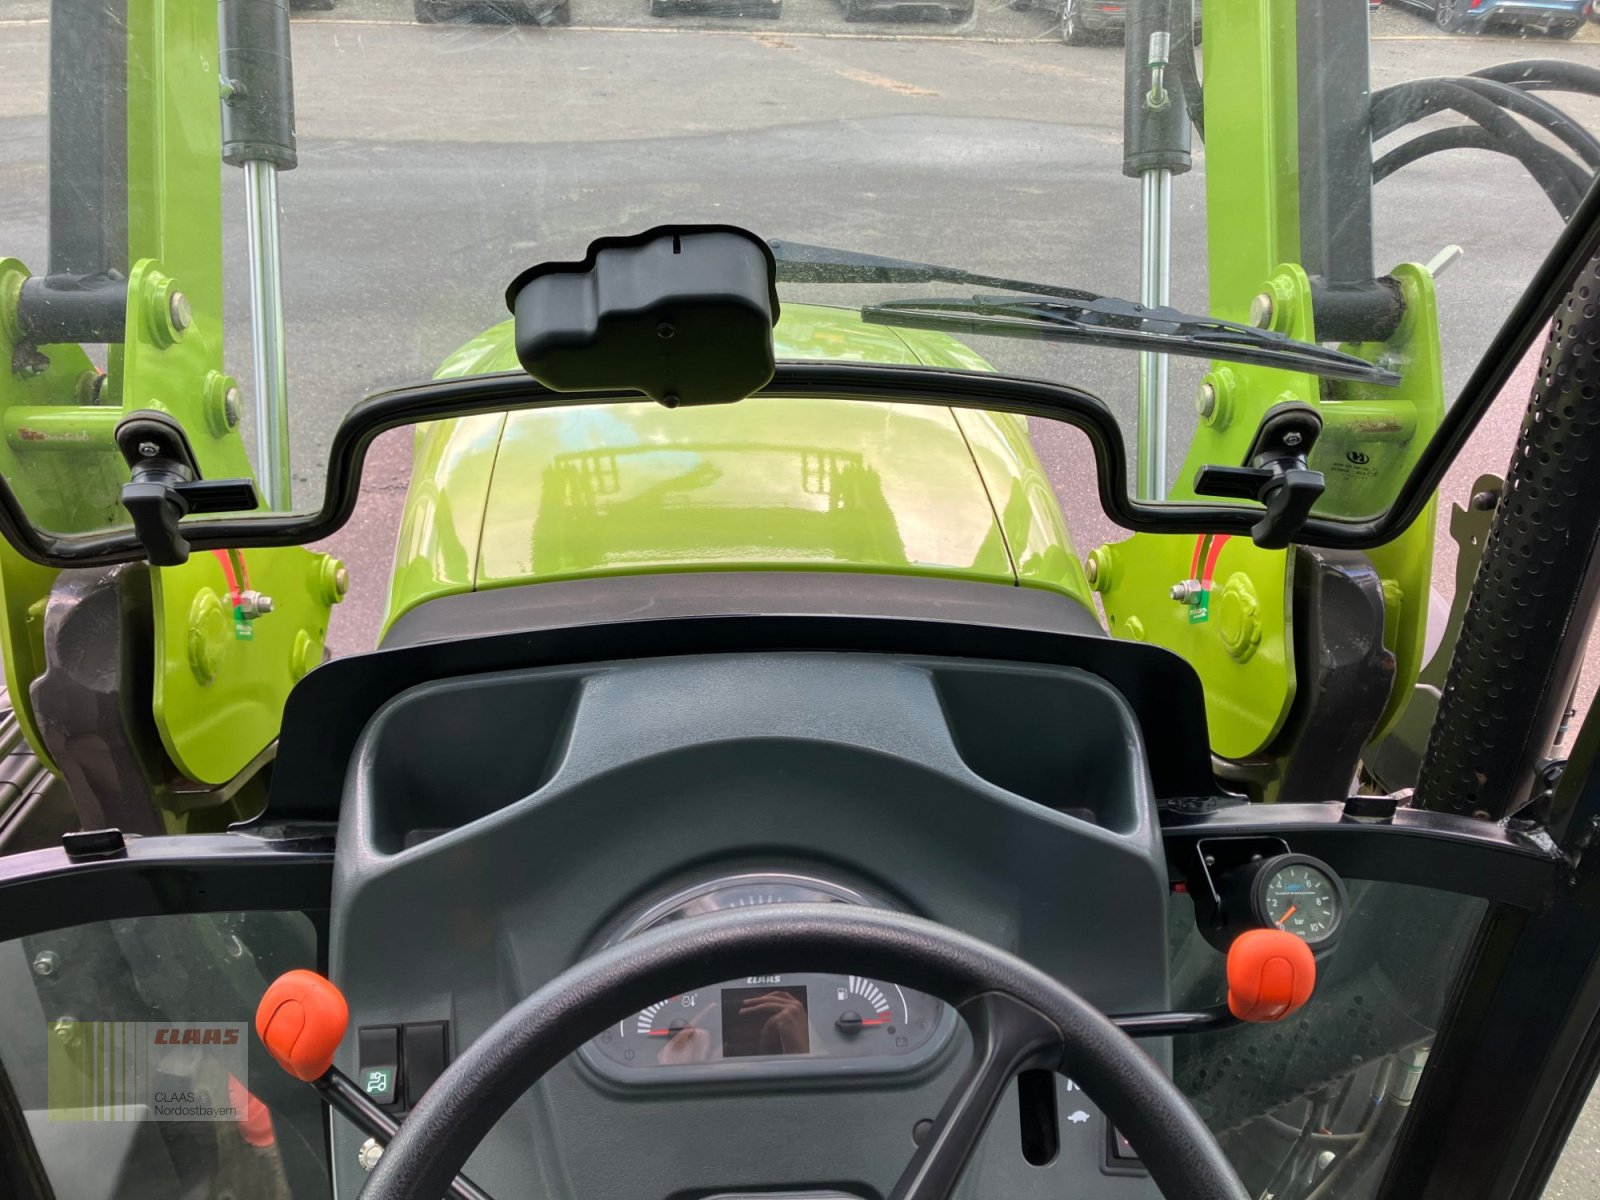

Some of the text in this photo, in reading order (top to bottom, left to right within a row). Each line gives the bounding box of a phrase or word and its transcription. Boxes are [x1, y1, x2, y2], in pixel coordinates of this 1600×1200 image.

[1306, 880, 1312, 888] 6
[1272, 899, 1278, 907] 2
[1316, 898, 1322, 906] 8
[1310, 923, 1318, 932] 10
[747, 975, 781, 984] CLAAS
